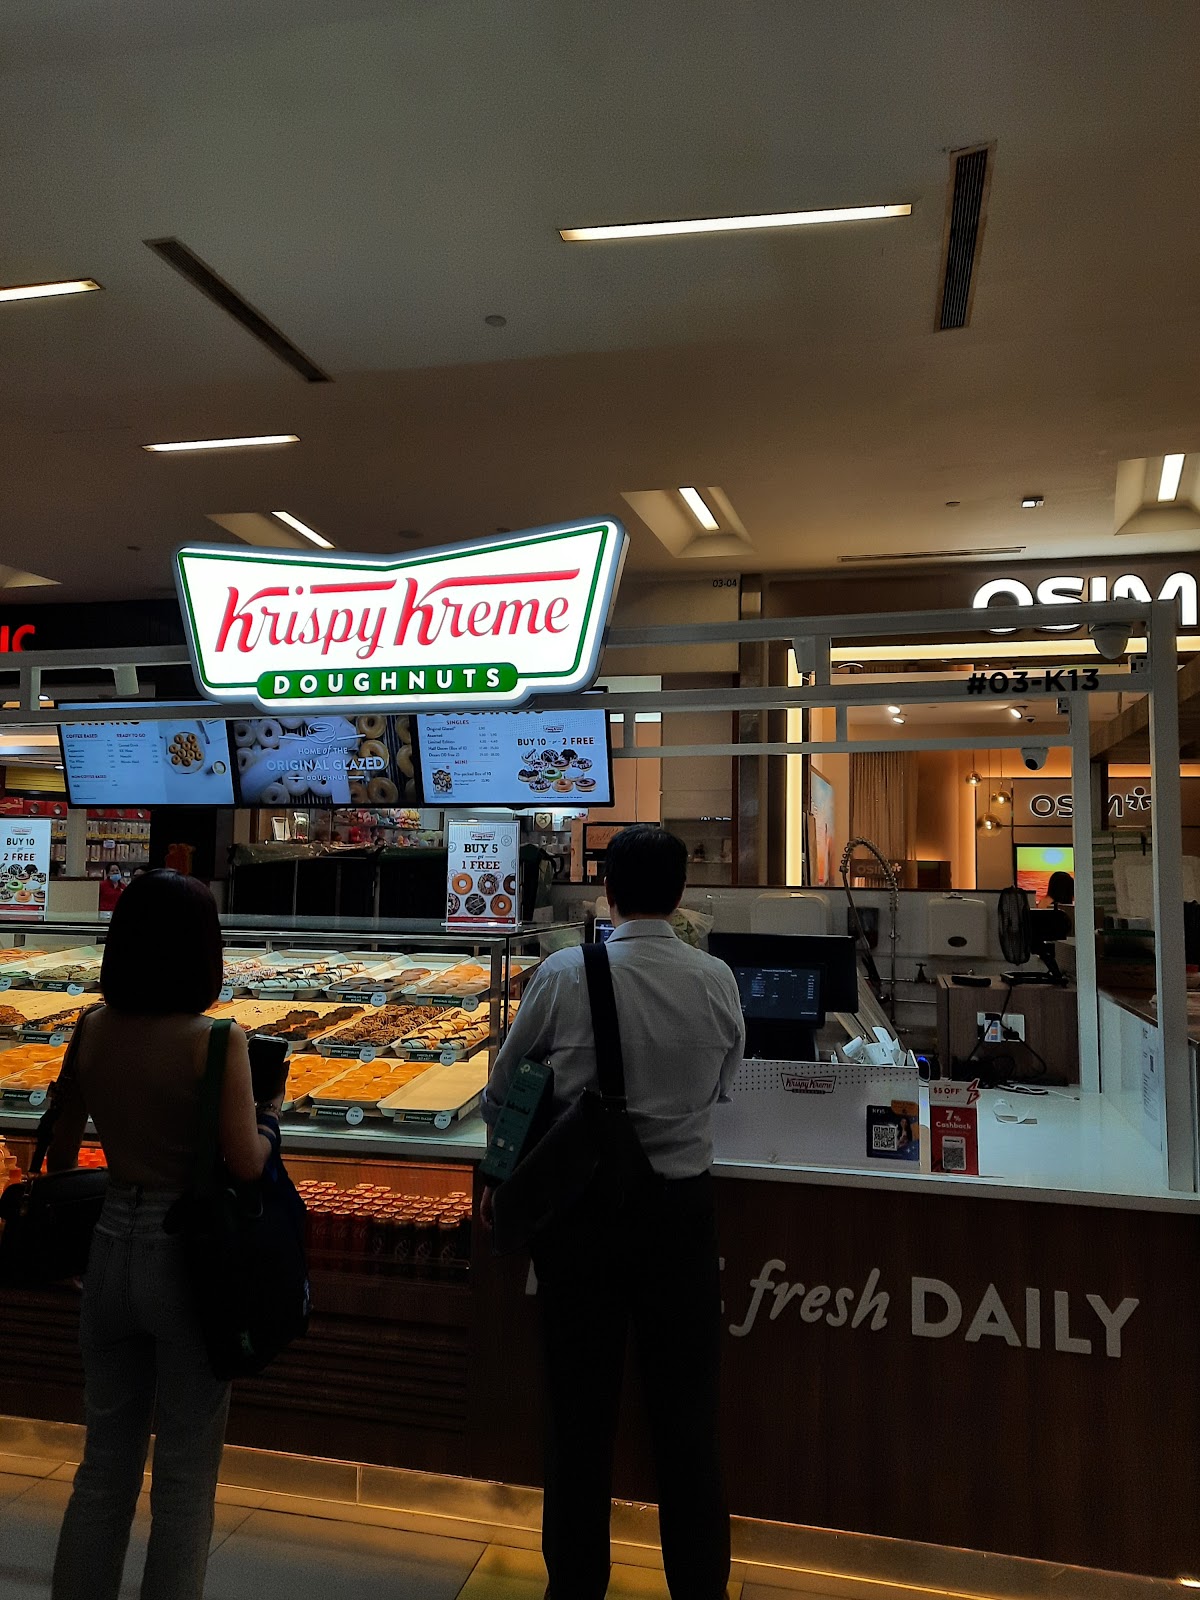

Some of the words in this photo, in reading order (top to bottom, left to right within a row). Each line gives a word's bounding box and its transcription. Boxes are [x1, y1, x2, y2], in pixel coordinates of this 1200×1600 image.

[712, 578, 737, 588] 03-04
[215, 579, 398, 661] Krispy
[393, 568, 581, 647] Kreme
[274, 668, 500, 694] DOUGHNUTS
[967, 668, 1099, 695] #03-K13
[517, 738, 535, 746] BUY
[537, 738, 546, 746] 10
[562, 737, 567, 745] 2
[298, 747, 321, 755] HOME
[323, 746, 333, 757] of
[266, 759, 330, 771] ORIGINAL
[333, 757, 385, 771] GLAZED
[6, 838, 25, 846] BUY
[26, 838, 35, 846] 10
[464, 844, 489, 853] BUY
[492, 844, 498, 853] 5
[3, 853, 9, 861] 2
[461, 861, 466, 870] 1
[786, 1078, 810, 1089] Krispy
[945, 1109, 962, 1122] 7%
[935, 1121, 972, 1130] Cashback
[728, 1258, 891, 1338] fresh
[911, 1276, 1140, 1359] DAILY
